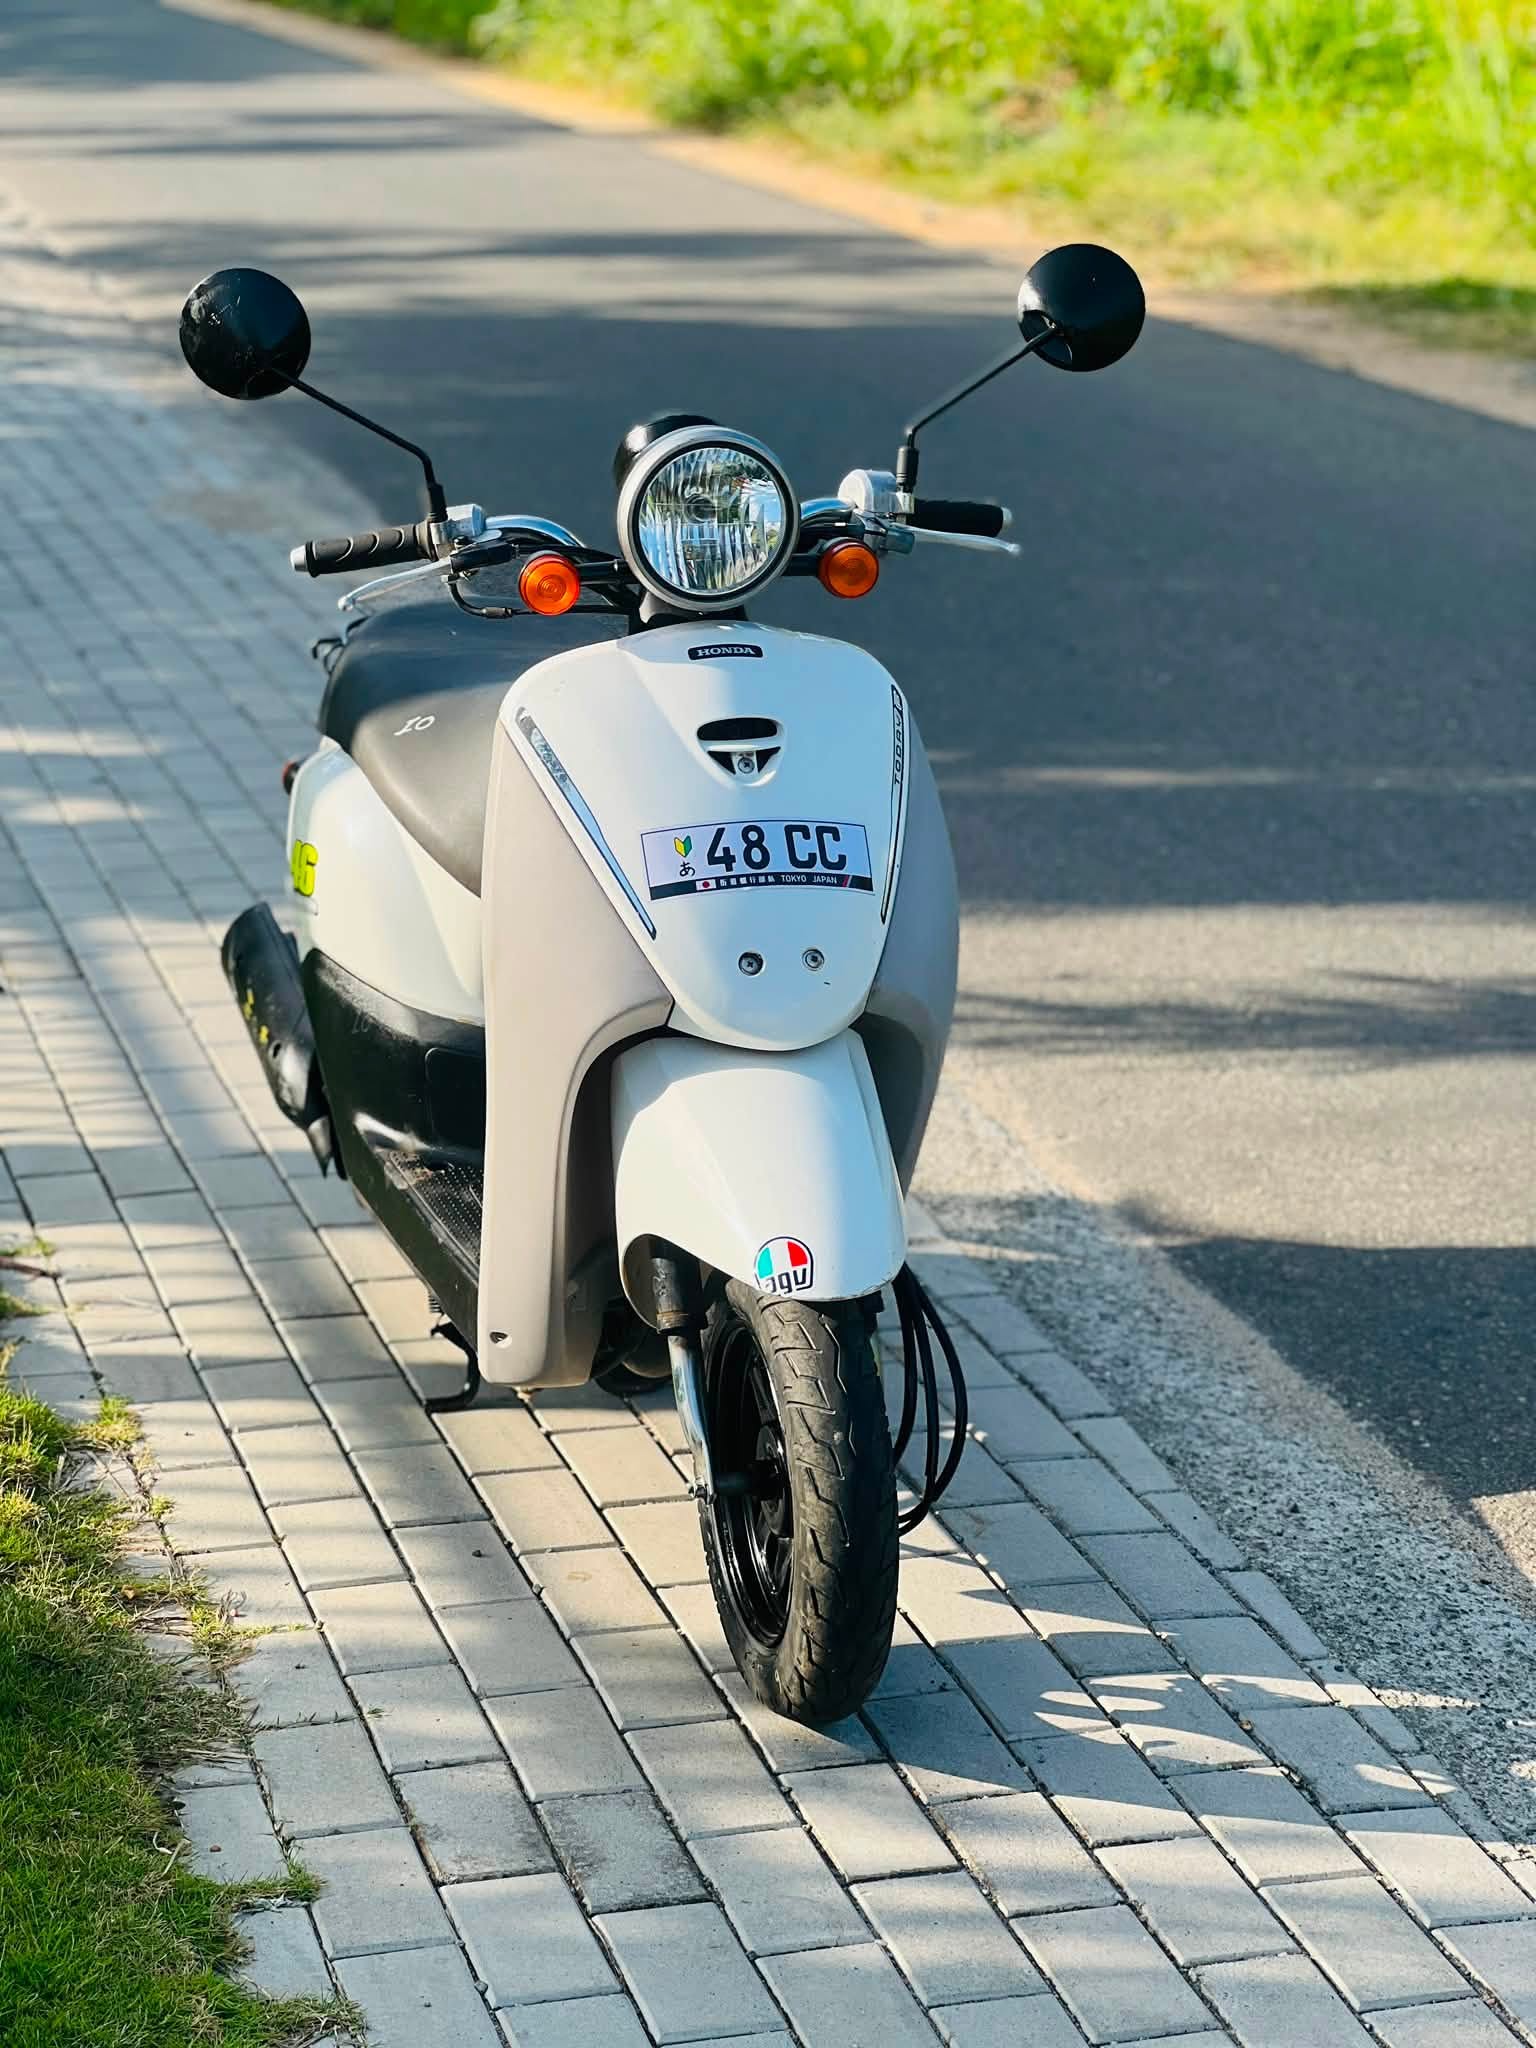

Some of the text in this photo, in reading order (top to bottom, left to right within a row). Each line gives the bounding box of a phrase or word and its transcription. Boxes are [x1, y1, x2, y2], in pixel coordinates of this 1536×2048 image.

[696, 646, 755, 657] HONDA
[706, 824, 847, 872] 48 CC
[679, 861, 696, 877] あ
[781, 874, 807, 883] TOKYO
[812, 875, 838, 884] JAPAN
